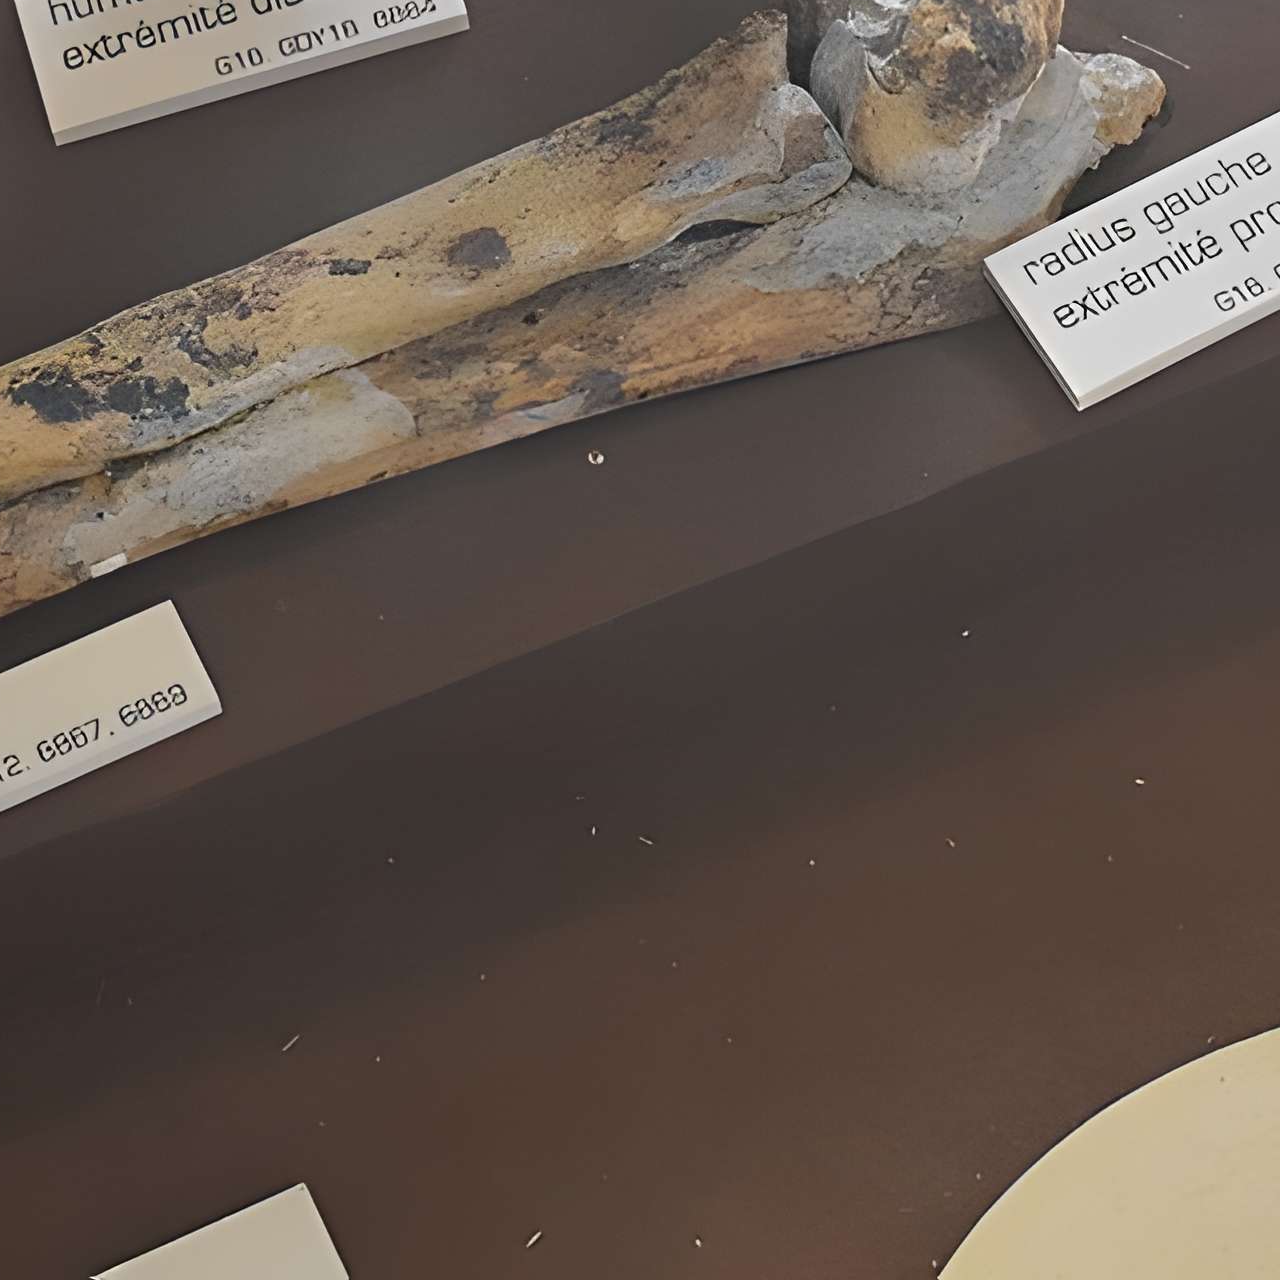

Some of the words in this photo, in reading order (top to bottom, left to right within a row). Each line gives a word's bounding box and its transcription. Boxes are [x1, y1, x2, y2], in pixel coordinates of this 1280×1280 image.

[1022, 216, 1137, 286] radius
[1143, 151, 1273, 234] gauche
[1052, 230, 1219, 330] extrémité
